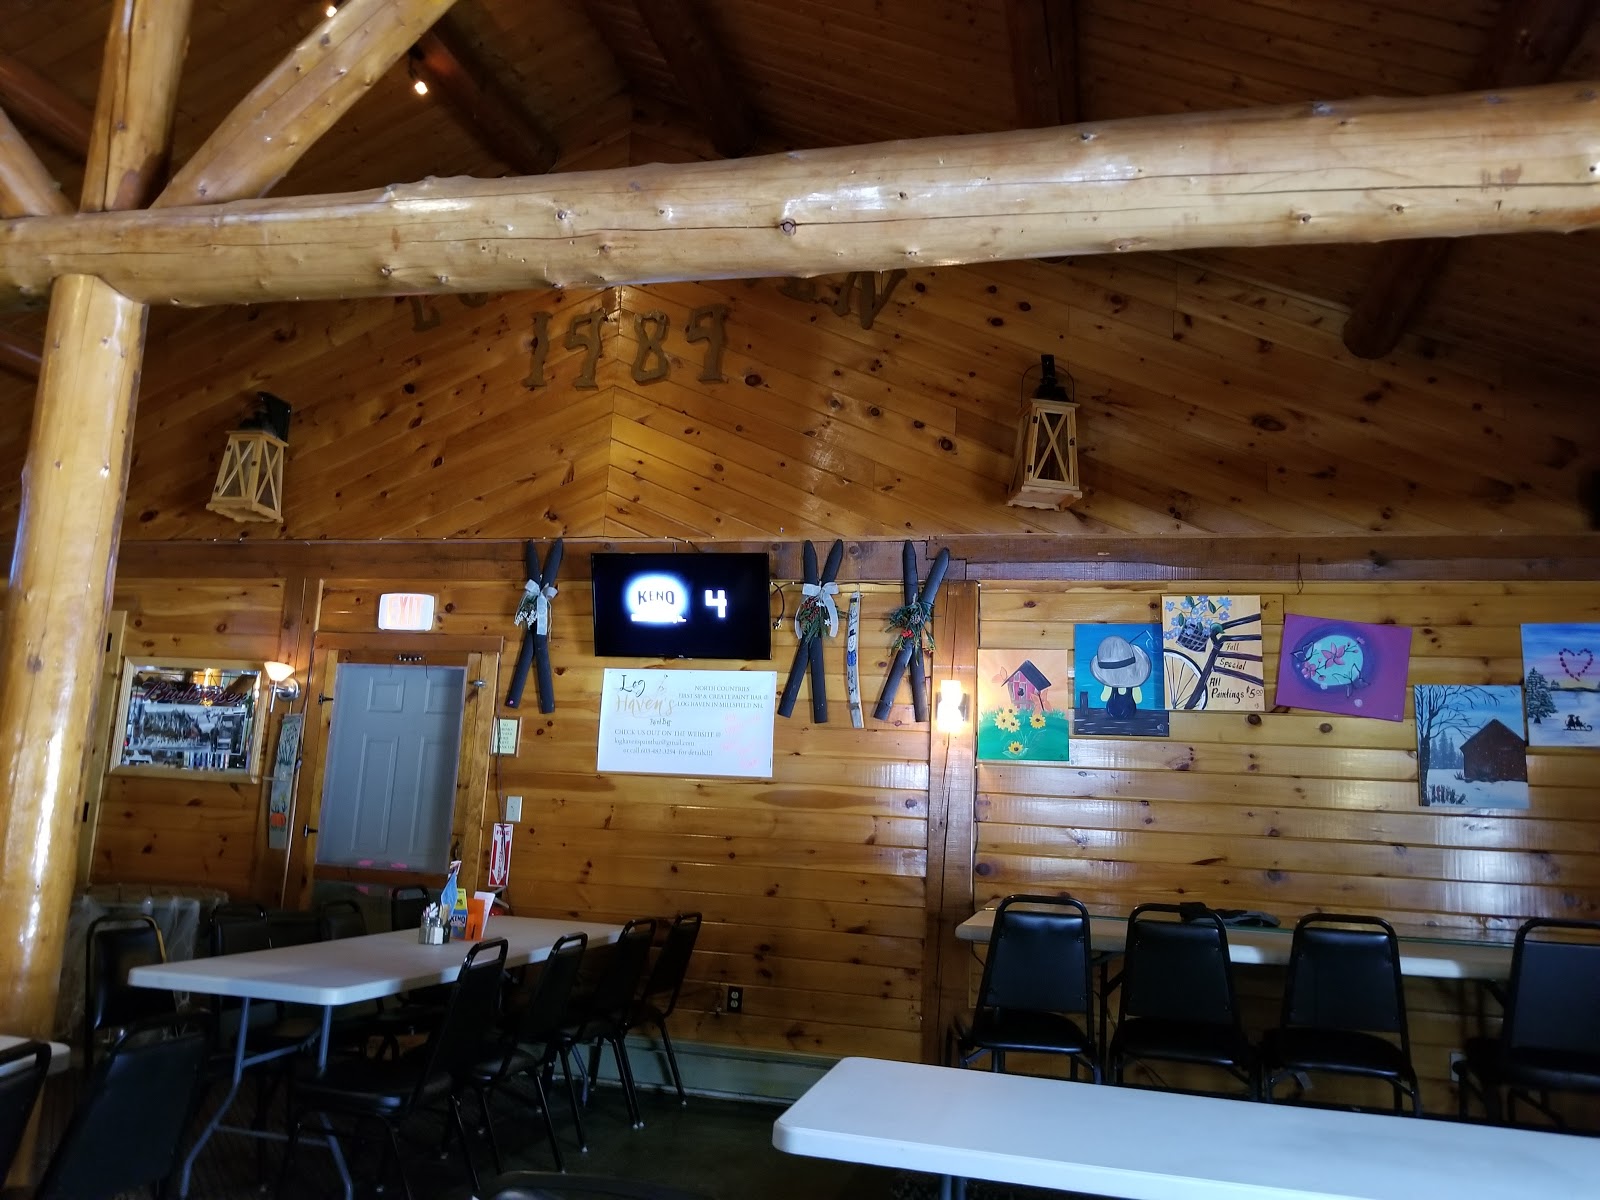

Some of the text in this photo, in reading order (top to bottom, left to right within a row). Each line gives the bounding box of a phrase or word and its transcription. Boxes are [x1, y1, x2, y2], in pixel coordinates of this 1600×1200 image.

[523, 302, 730, 391] 1989
[387, 596, 425, 625] EXIT
[637, 589, 727, 618] KENO 4
[1226, 643, 1240, 651] Fall
[1220, 658, 1246, 670] Special
[619, 674, 646, 698] Log
[1209, 678, 1220, 687] All
[616, 693, 674, 718] Haven's
[1211, 688, 1245, 704] Paintings
